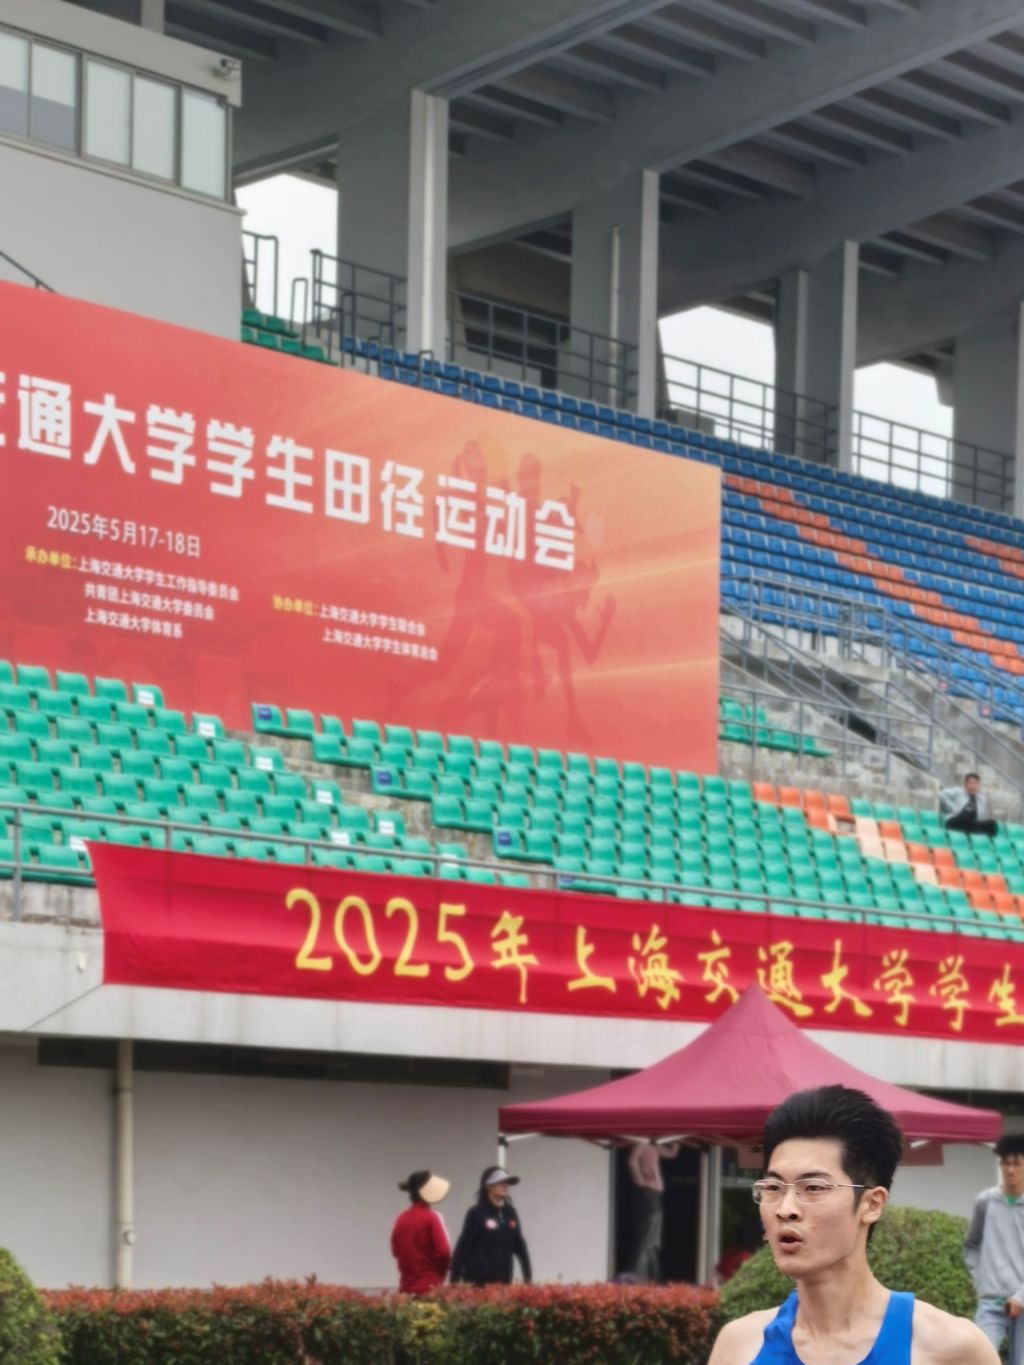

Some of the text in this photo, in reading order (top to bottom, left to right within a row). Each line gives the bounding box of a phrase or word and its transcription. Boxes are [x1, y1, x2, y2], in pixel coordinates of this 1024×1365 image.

[0, 371, 576, 571] 通大学学生田径运动会
[47, 506, 201, 558] 2025年5月17-18日
